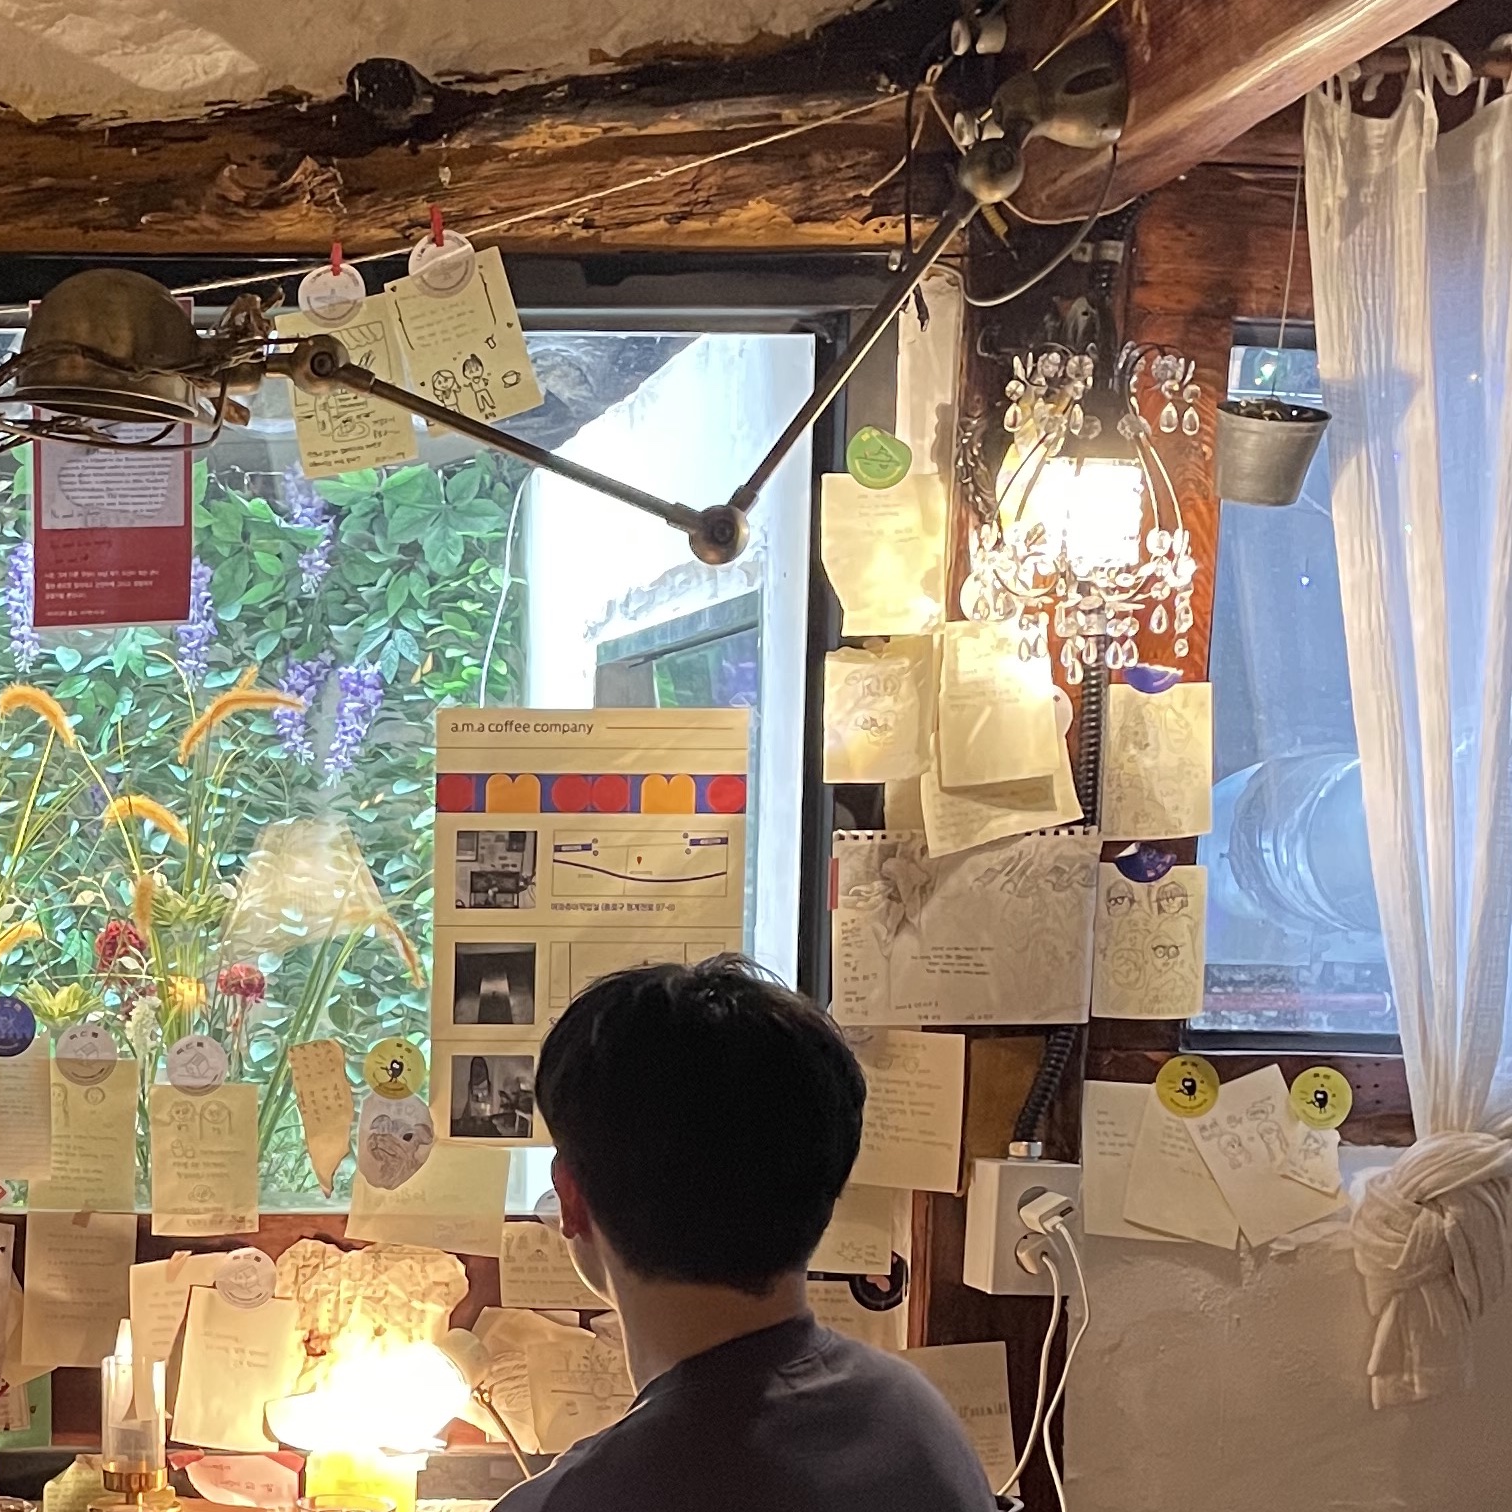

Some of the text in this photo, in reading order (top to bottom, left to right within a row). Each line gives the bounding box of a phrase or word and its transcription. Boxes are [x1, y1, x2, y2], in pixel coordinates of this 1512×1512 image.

[450, 720, 594, 735] a.m.a coffee company
